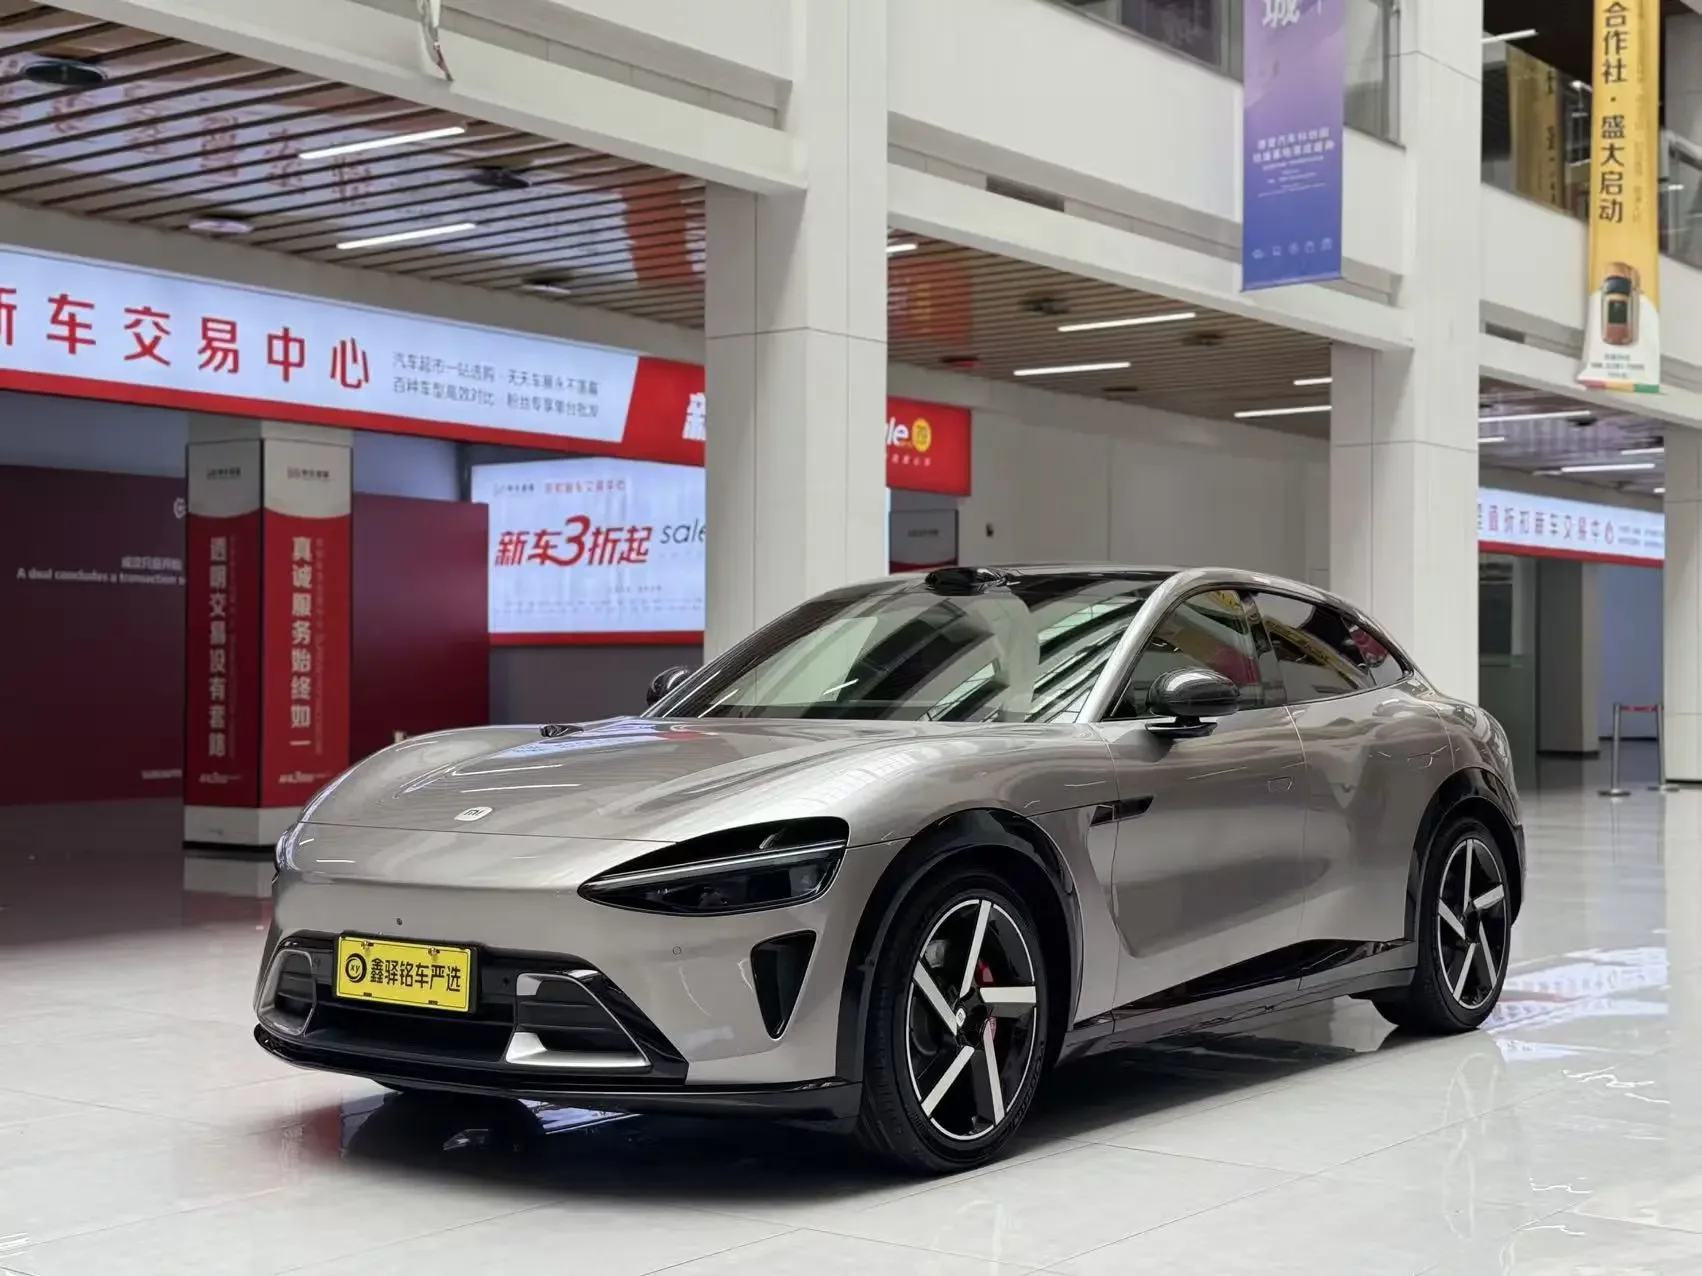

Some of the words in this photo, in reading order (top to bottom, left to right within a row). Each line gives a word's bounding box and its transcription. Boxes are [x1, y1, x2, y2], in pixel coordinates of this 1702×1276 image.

[290, 535, 312, 745] 真诚服务始终如一
[370, 957, 461, 992] 鑫驿铭车严选
